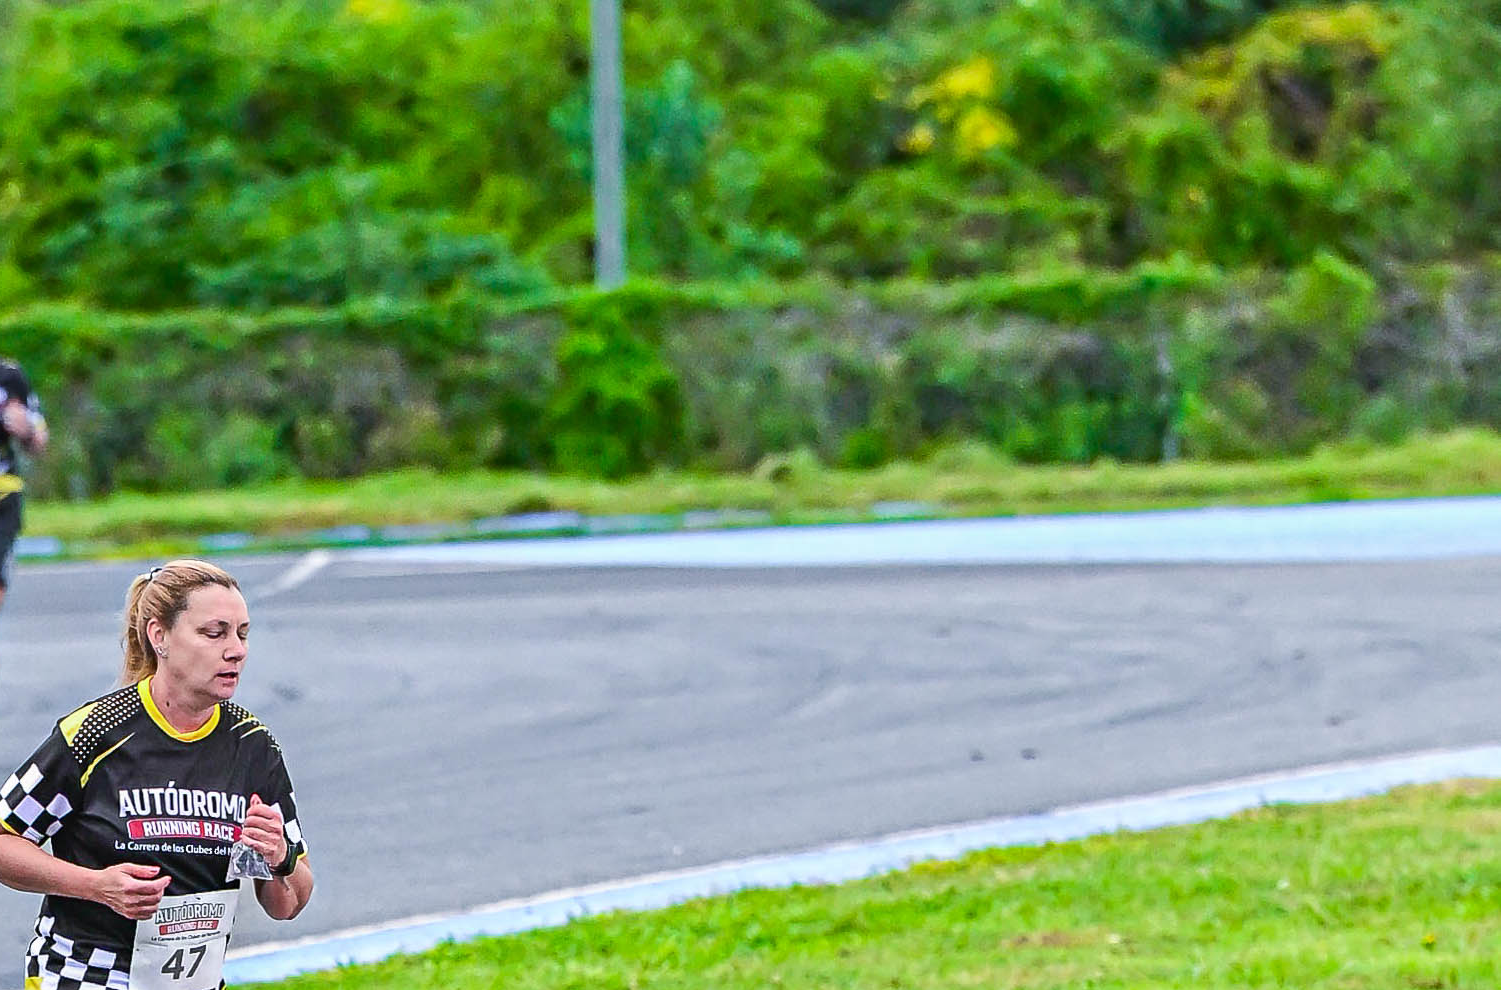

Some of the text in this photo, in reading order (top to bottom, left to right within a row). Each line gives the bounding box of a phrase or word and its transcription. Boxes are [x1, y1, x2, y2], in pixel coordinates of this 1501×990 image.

[118, 780, 247, 824] AUTÓDROMO
[143, 820, 235, 842] RUNNING RACE
[114, 839, 126, 850] La
[128, 841, 160, 852] Carrera
[161, 842, 172, 853] de
[172, 843, 185, 853] los
[186, 844, 213, 855] Clubes
[214, 845, 227, 856] del
[154, 900, 226, 925] AUTÓDROMO
[160, 944, 207, 981] 47
